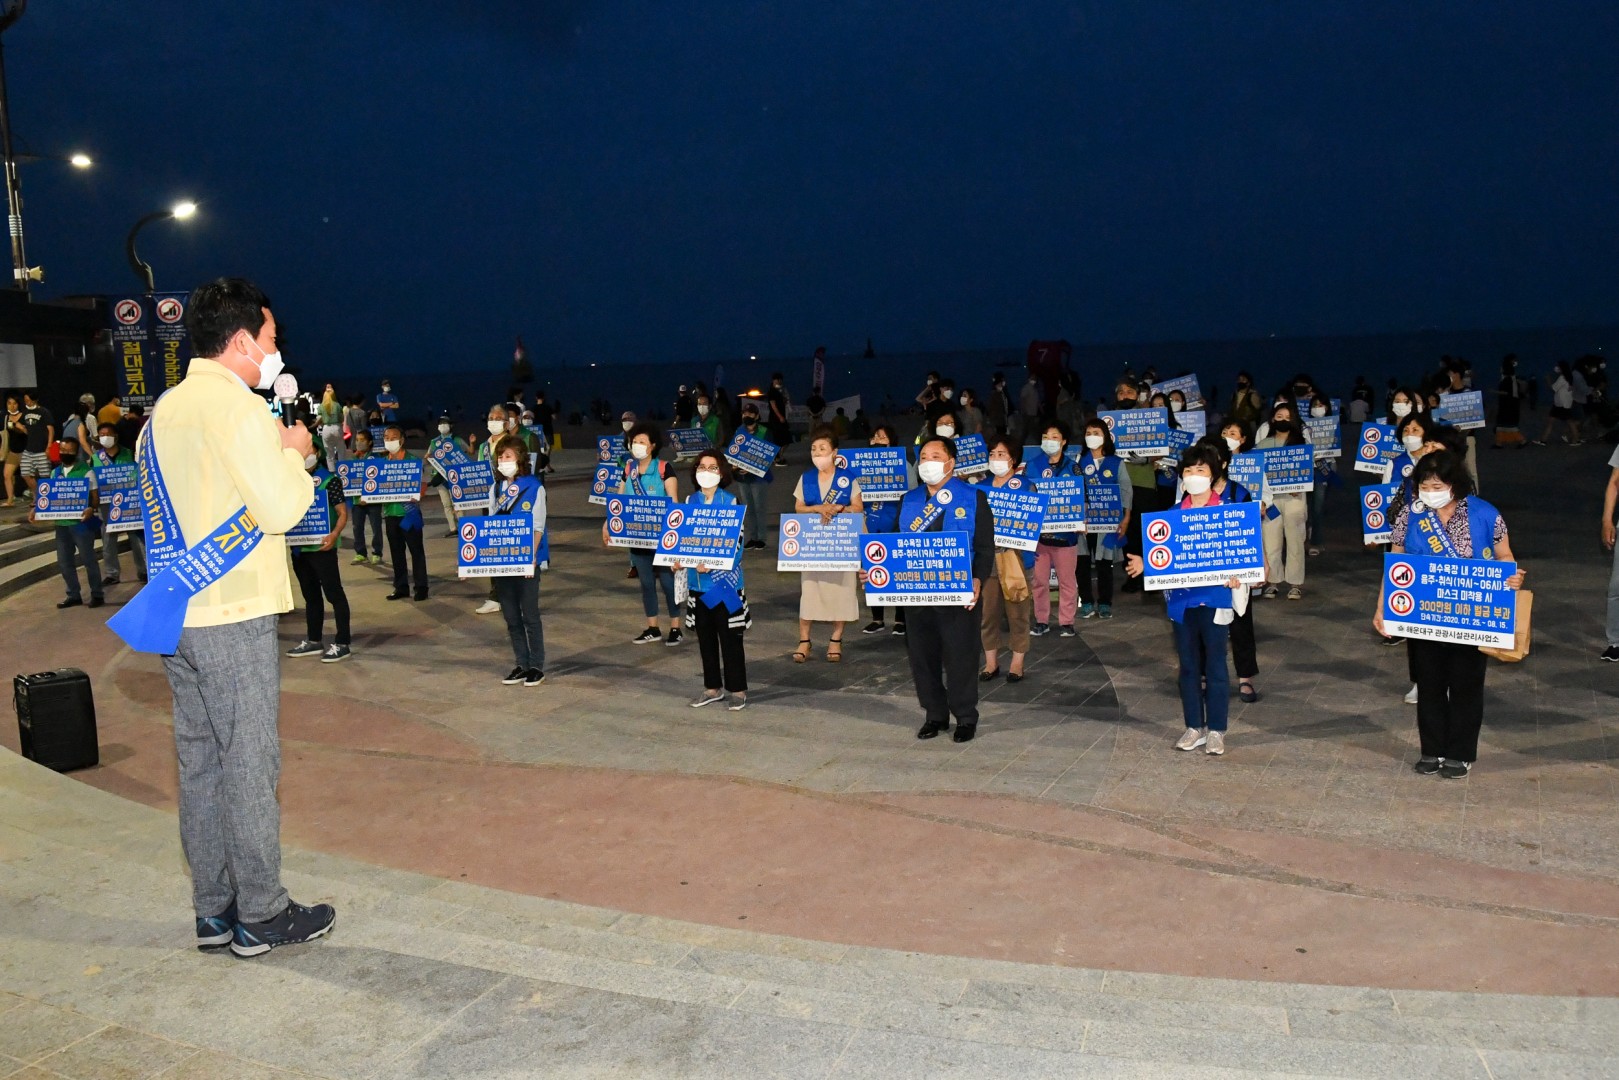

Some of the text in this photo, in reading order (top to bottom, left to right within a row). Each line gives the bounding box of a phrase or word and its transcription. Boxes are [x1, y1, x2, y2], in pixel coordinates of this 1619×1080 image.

[122, 341, 146, 394] 절대금지
[164, 340, 181, 388] Prohibitio
[140, 434, 166, 544] Prohibition
[988, 491, 1010, 500] 해수욕장
[1027, 496, 1039, 504] 이상
[991, 508, 1006, 516] 마스크
[1006, 510, 1022, 518] 미착용
[1182, 512, 1208, 524] Drinking
[1223, 509, 1245, 520] Eating
[1189, 523, 1202, 531] with
[1204, 522, 1222, 530] more
[1242, 527, 1254, 535] and
[898, 537, 958, 547] 해수욕장 내 2인 이상
[1182, 542, 1193, 550] Not
[1195, 540, 1221, 550] wearing
[1229, 538, 1246, 546] mask
[959, 548, 966, 556] 및
[1198, 550, 1214, 558] fined
[1224, 548, 1235, 556] the
[1236, 546, 1256, 555] beach
[907, 559, 952, 568] 마스크 미착용 시
[1174, 561, 1196, 569] Regulation
[894, 570, 968, 581] 300만원 이하 벌금 부과
[1429, 562, 1501, 578] 해수욕장 내 2인 이상
[1157, 576, 1186, 586] Haeundae-gu
[1204, 573, 1218, 582] Facility
[1219, 571, 1246, 581] Management
[1247, 569, 1260, 578] Office
[1436, 588, 1492, 602] 마스크 미착용 시
[1419, 599, 1510, 619] 300만원 이하 벌금 부과
[1406, 626, 1499, 643] 해운대구 관광시설관리사업소
